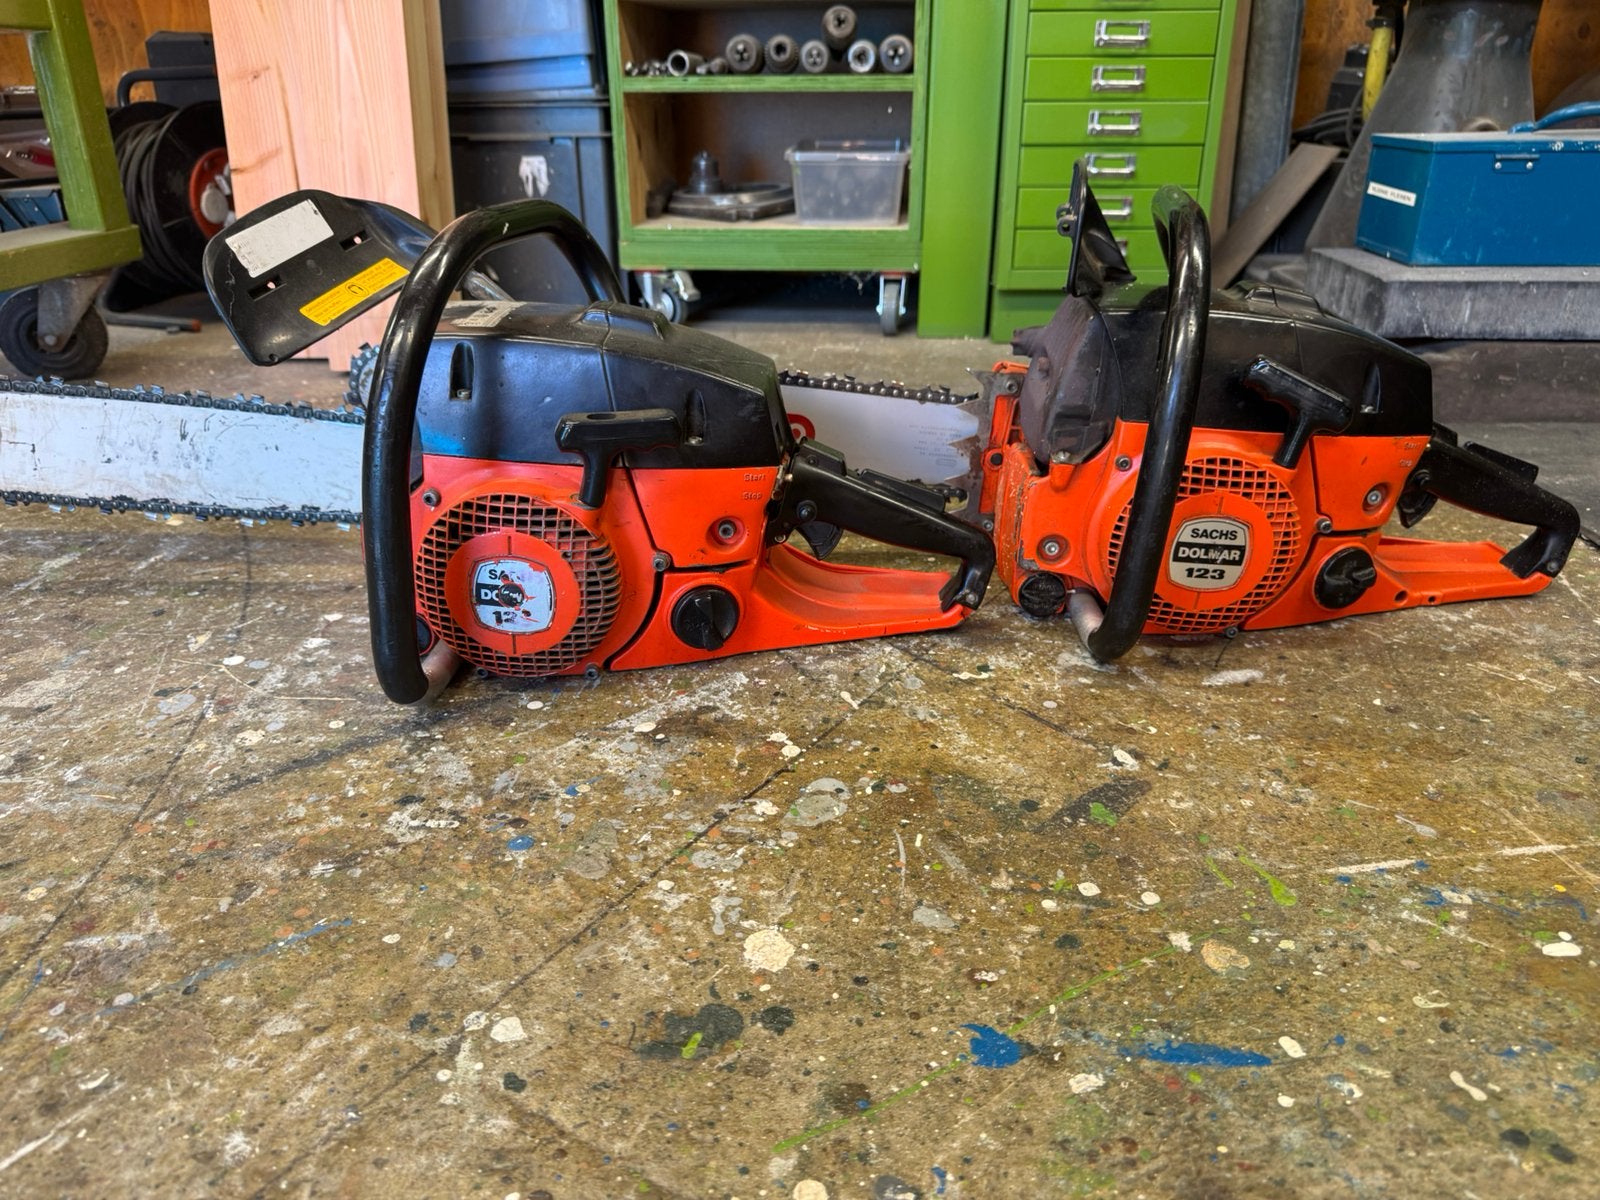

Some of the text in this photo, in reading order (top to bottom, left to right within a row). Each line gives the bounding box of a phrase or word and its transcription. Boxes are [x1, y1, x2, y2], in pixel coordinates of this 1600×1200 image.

[743, 472, 766, 481] Start
[743, 491, 763, 501] Stop
[1190, 528, 1238, 541] SACHS
[1178, 546, 1241, 561] DOLMAR
[1185, 567, 1226, 580] 123
